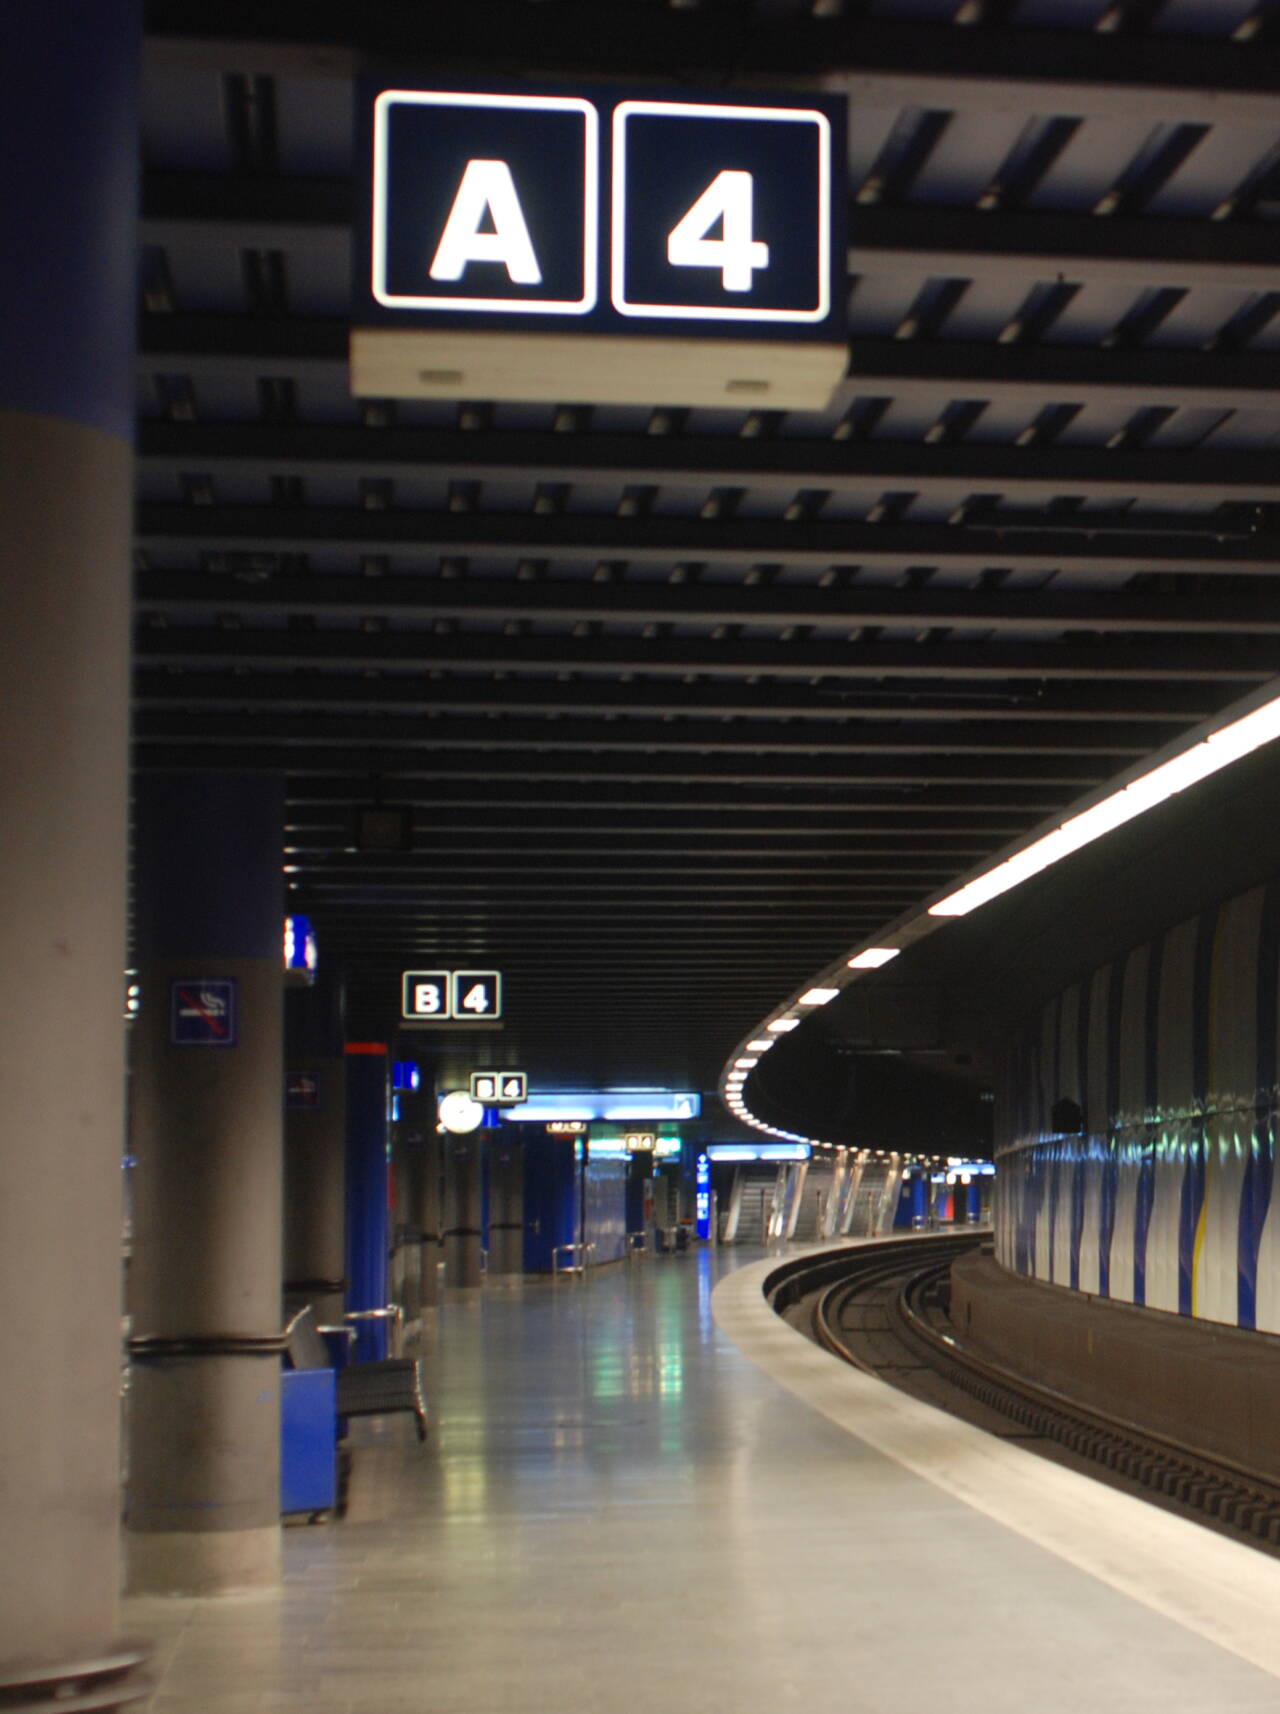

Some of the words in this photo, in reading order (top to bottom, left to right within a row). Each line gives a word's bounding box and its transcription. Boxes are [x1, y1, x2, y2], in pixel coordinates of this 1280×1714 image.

[429, 159, 543, 285] A
[667, 169, 770, 292] 4
[415, 984, 440, 1013] B
[463, 984, 489, 1013] 4
[503, 1079, 520, 1098] 4
